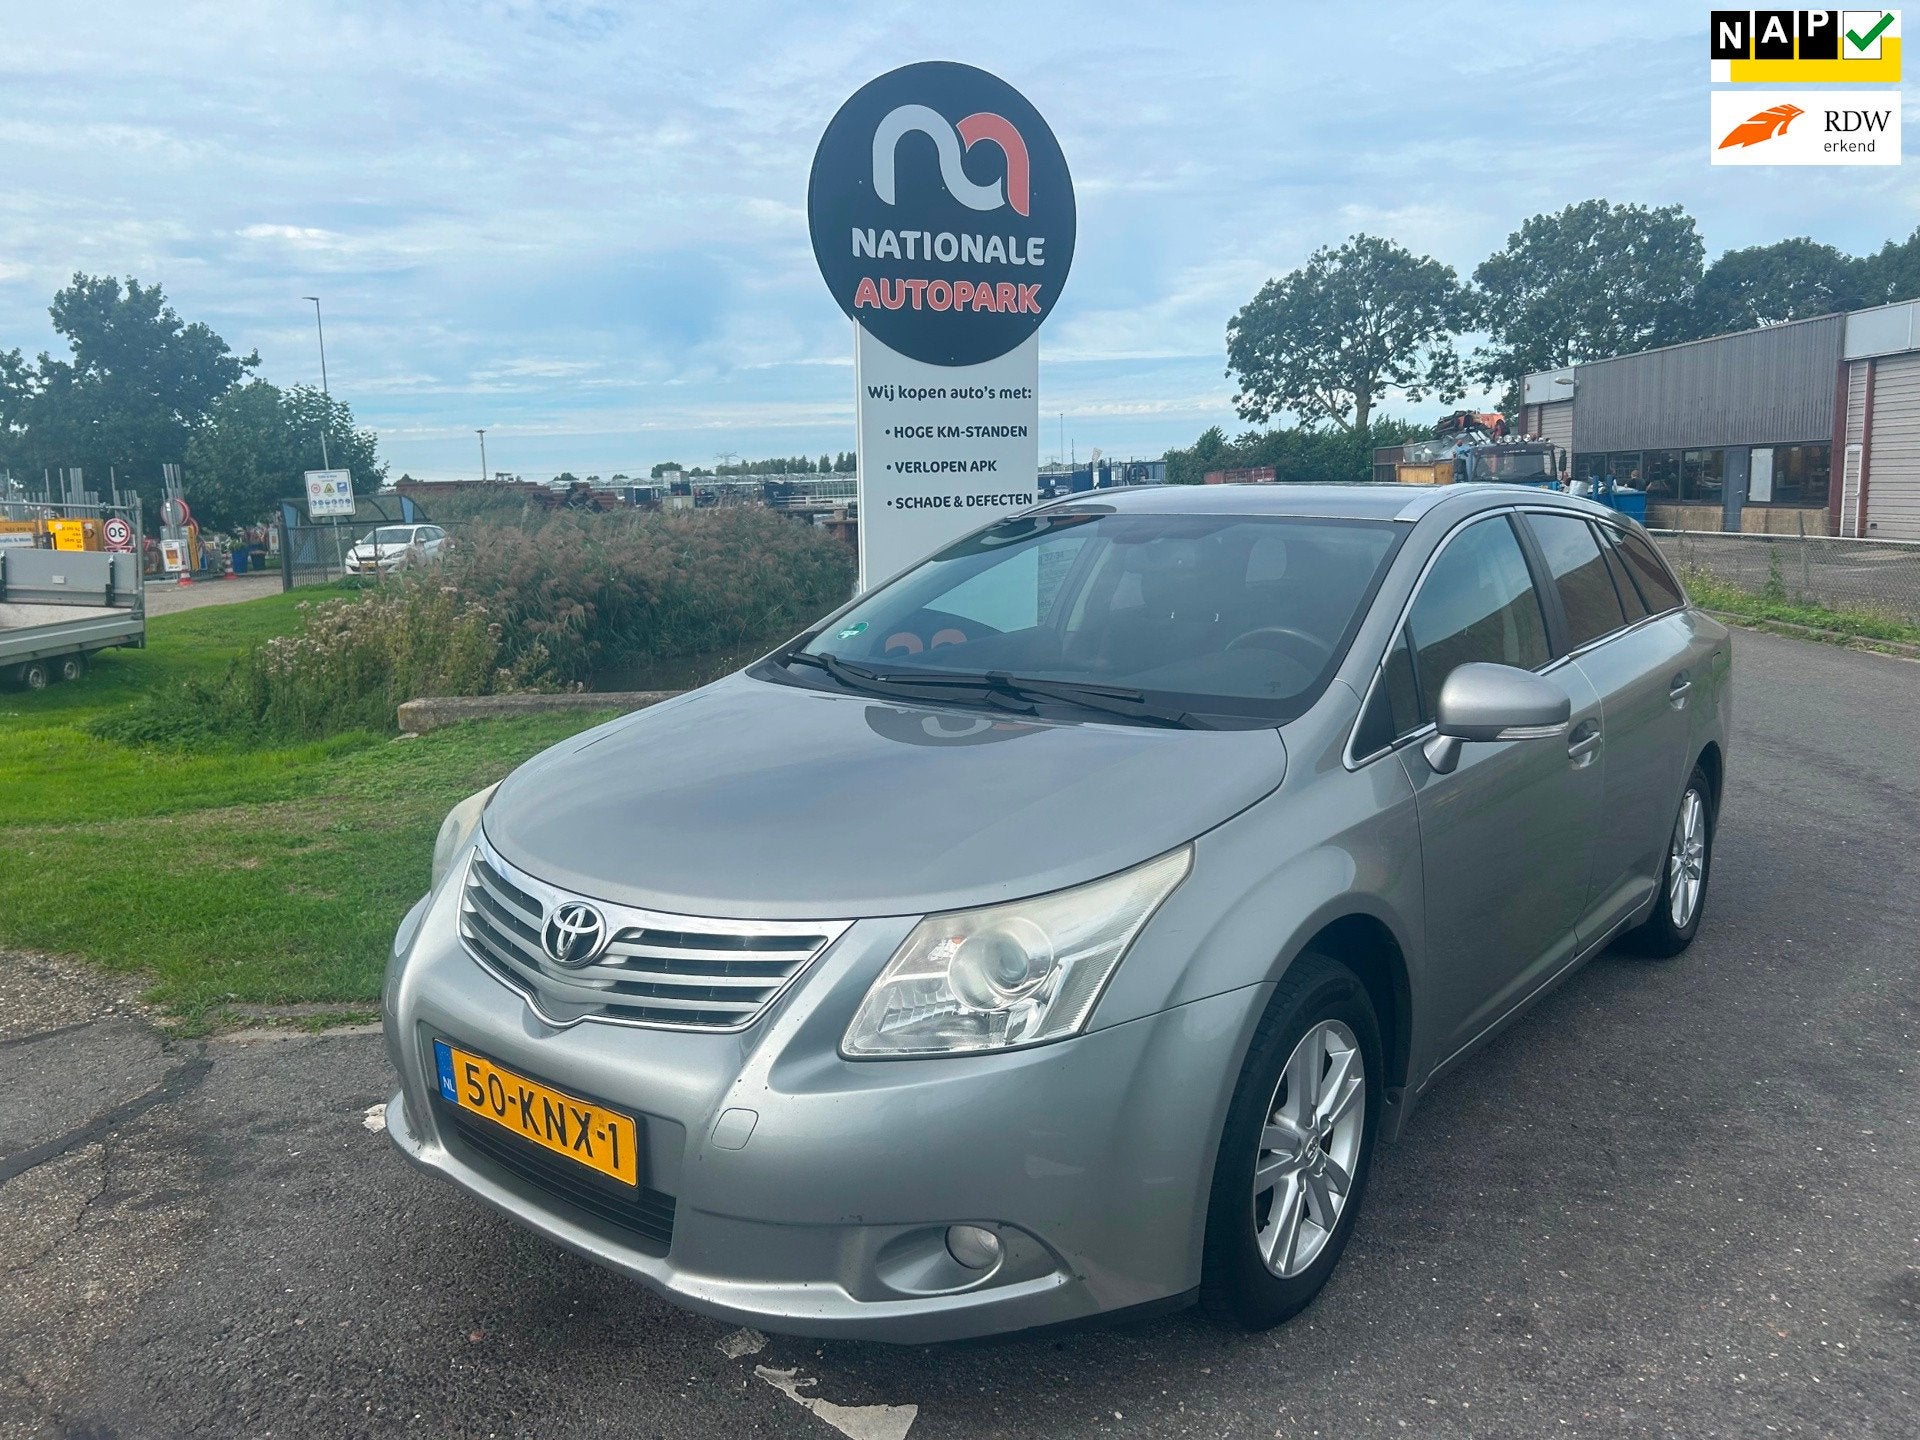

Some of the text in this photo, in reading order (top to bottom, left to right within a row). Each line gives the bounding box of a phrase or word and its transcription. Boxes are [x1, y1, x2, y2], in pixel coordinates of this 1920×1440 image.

[851, 227, 1045, 266] NATIONALE
[854, 277, 1042, 314] AUTOPARK
[867, 385, 1032, 402] Wij kopen auto's met:
[894, 425, 1028, 439] HOGE KM-STANDEN
[895, 460, 997, 474] VERLOPEN APK
[895, 493, 1033, 509] SCHADE & DEFECTEN
[108, 527, 126, 538] 30
[442, 1076, 456, 1093] NL
[465, 1061, 619, 1170] 50-KNX-1
